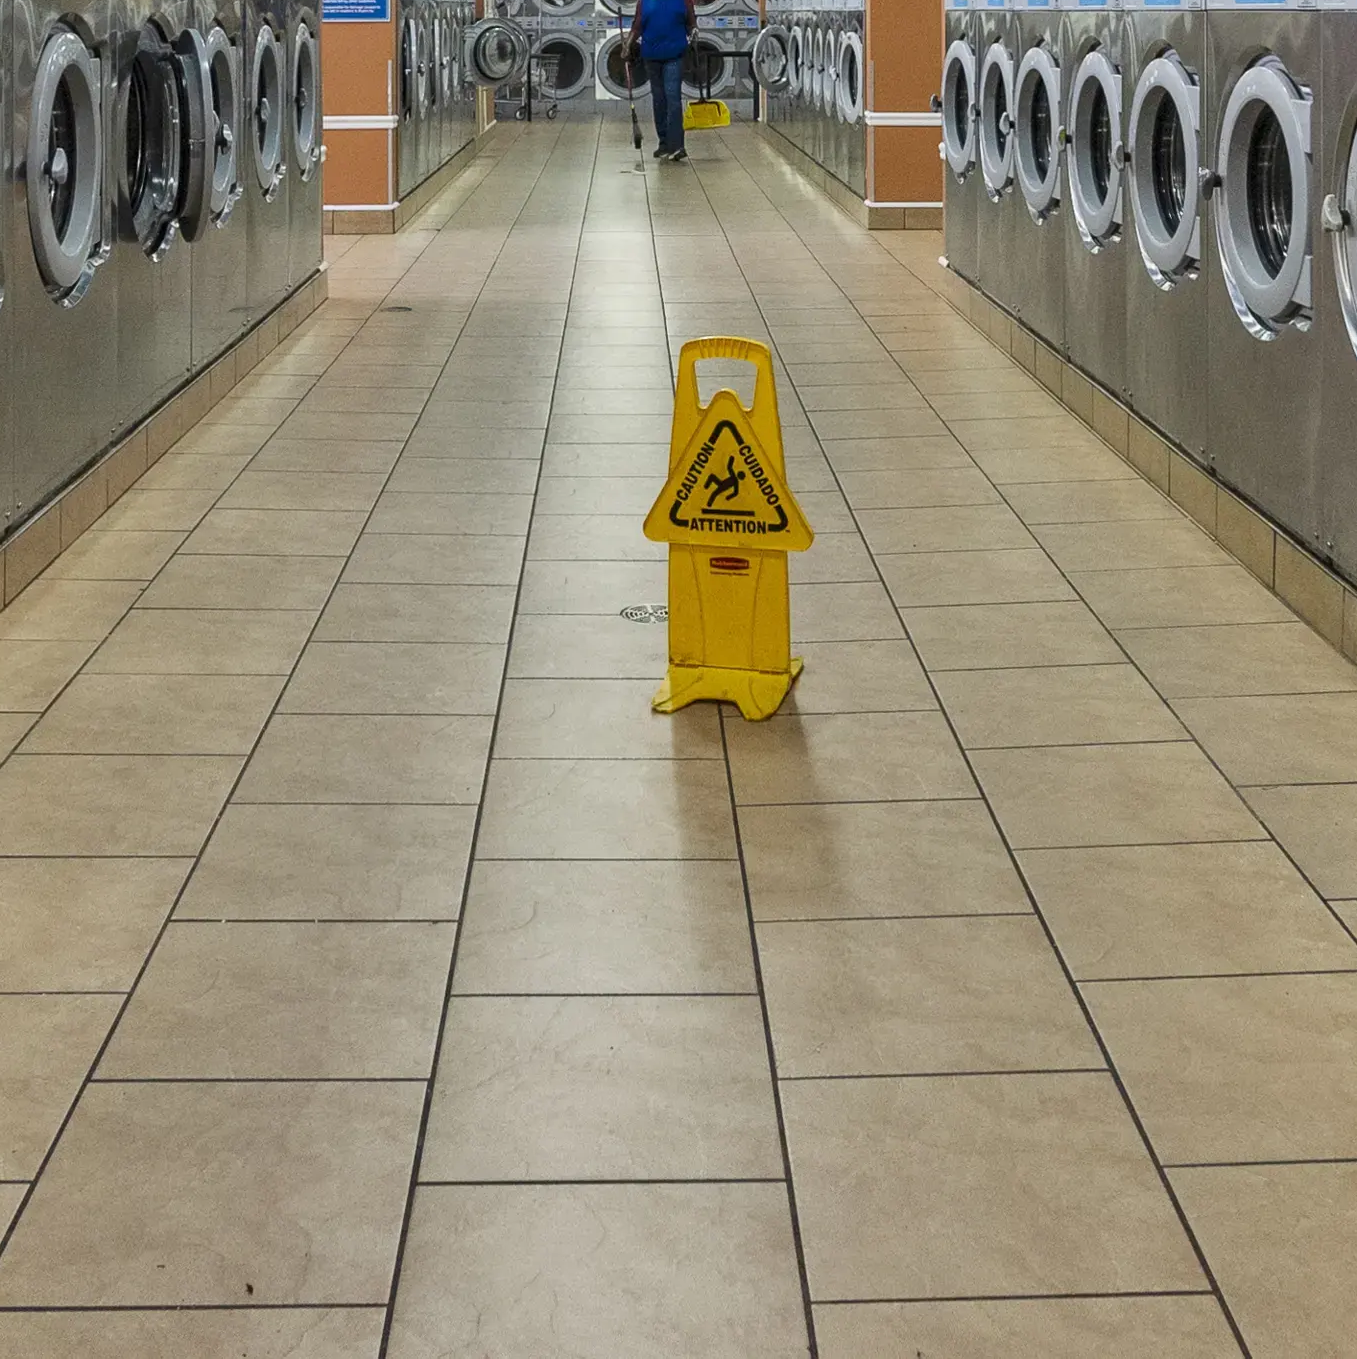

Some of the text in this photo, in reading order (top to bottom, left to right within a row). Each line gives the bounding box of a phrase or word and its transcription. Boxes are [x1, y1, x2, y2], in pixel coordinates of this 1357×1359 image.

[676, 442, 715, 501] CAUTION
[739, 445, 779, 506] CUIDADO
[690, 518, 767, 534] ATTENTION
